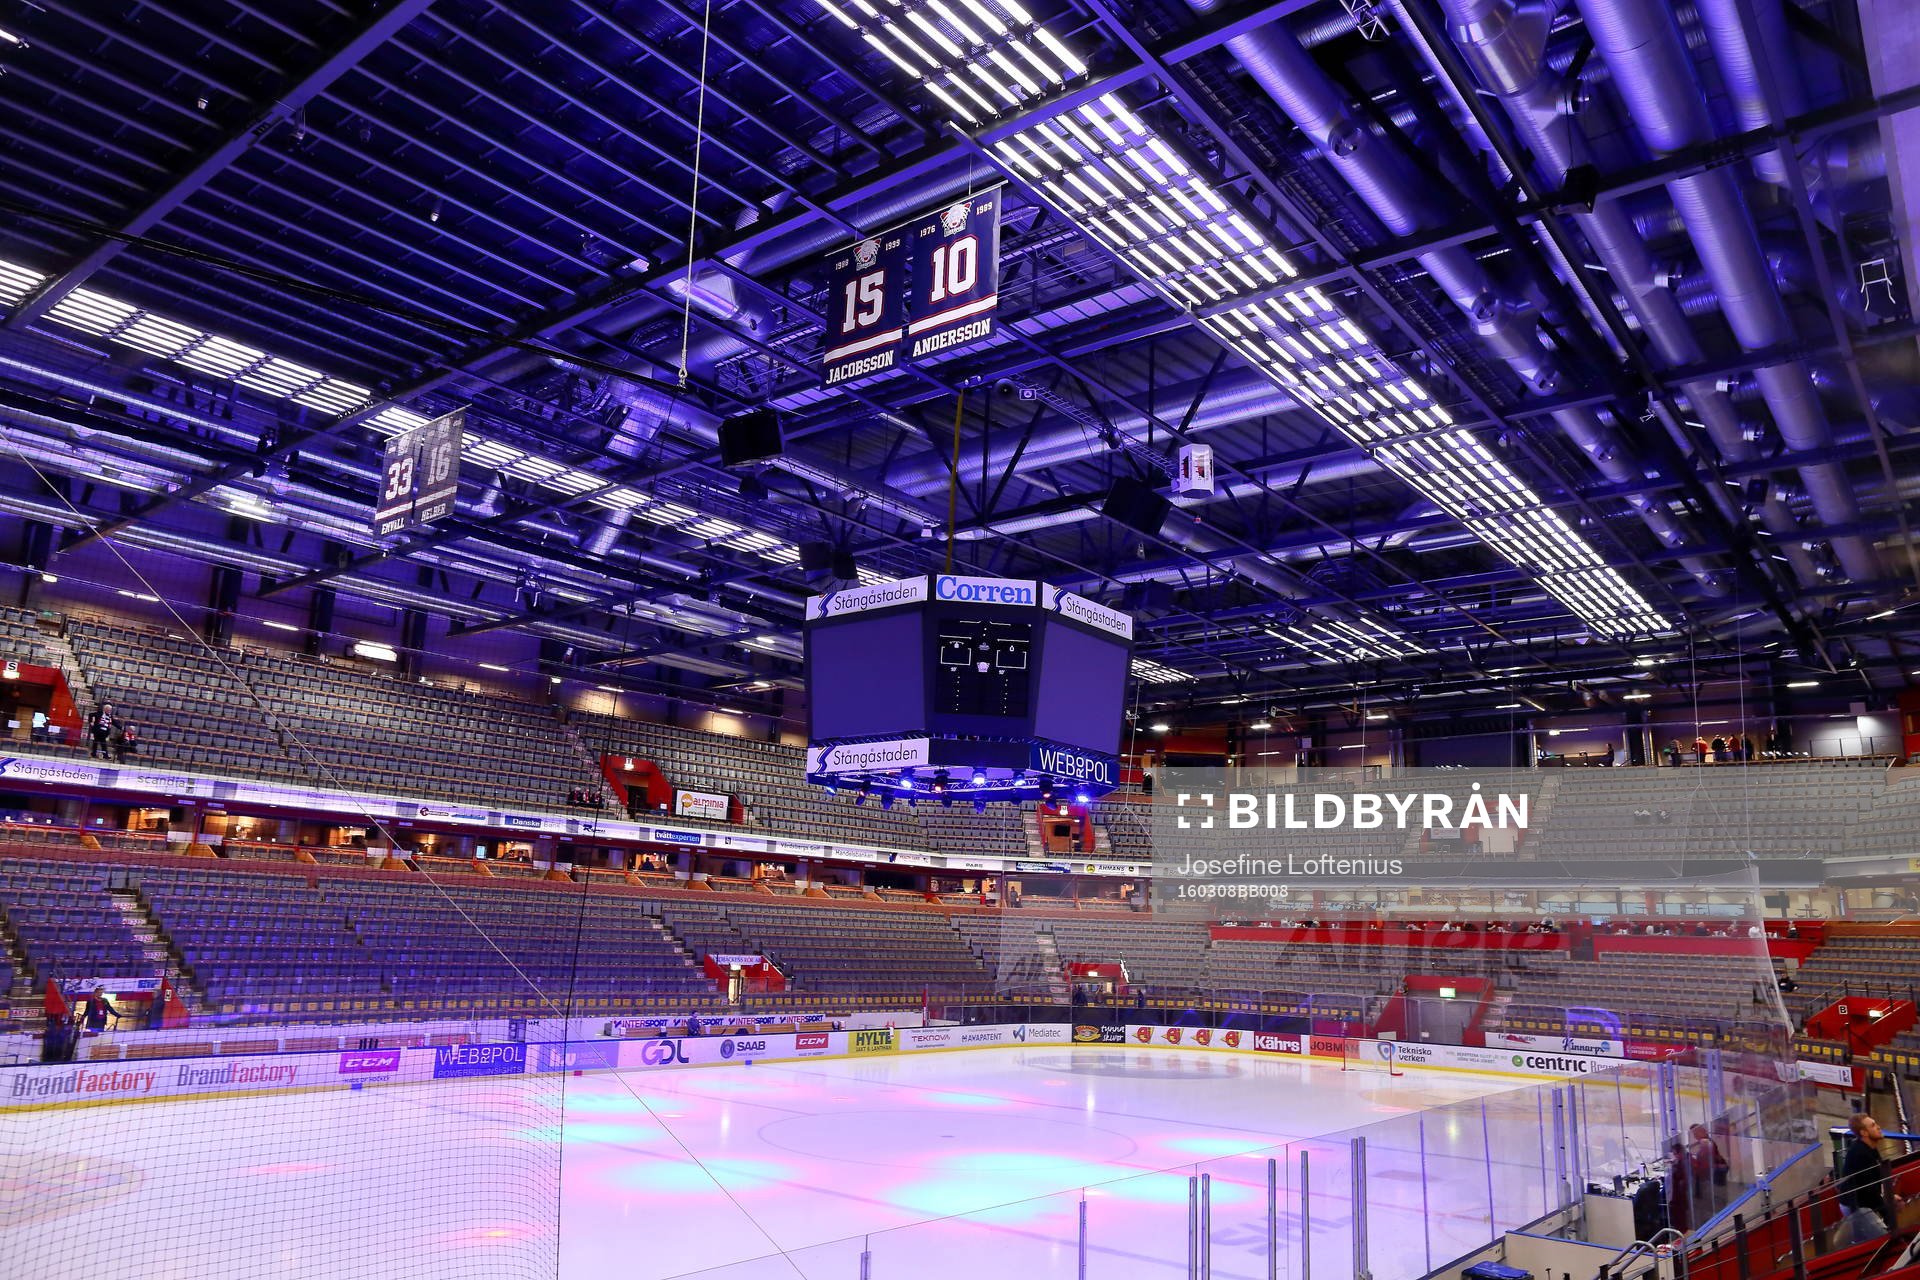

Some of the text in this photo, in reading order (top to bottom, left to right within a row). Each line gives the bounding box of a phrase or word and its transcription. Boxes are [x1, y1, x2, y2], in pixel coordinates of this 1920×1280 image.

[931, 236, 976, 302] 10
[843, 271, 884, 332] 15
[913, 318, 991, 357] ANDERSSON
[826, 350, 894, 384] JACOBSSON
[428, 442, 451, 485] 16
[385, 457, 413, 500] 33
[834, 583, 918, 612] Stångåstaden
[936, 576, 1033, 605] Corren
[1066, 596, 1127, 633] Stångåstaden
[833, 743, 918, 769] Stångåstaden
[13, 762, 94, 781] Stångåstaden
[513, 818, 541, 828] Danske
[656, 831, 700, 843] tvättexperten
[836, 849, 874, 858] Handelsbanken
[622, 1019, 668, 1028] INTERSPORT
[735, 1016, 775, 1026] INTERSPORT
[786, 1014, 824, 1023] INTERSPORT
[856, 1032, 891, 1045] HYLTE
[912, 1034, 950, 1042] TEKNOVA
[1029, 1028, 1061, 1038] Mediatec
[737, 1041, 765, 1051] SAAB
[1255, 1033, 1300, 1052] Kährs
[1398, 1046, 1432, 1056] Tekniska
[345, 1057, 394, 1068] CCM
[1398, 1055, 1426, 1063] verken
[1526, 1056, 1587, 1073] centric
[12, 1070, 156, 1097] BrandFactory
[177, 1062, 299, 1087] BrandFactory
